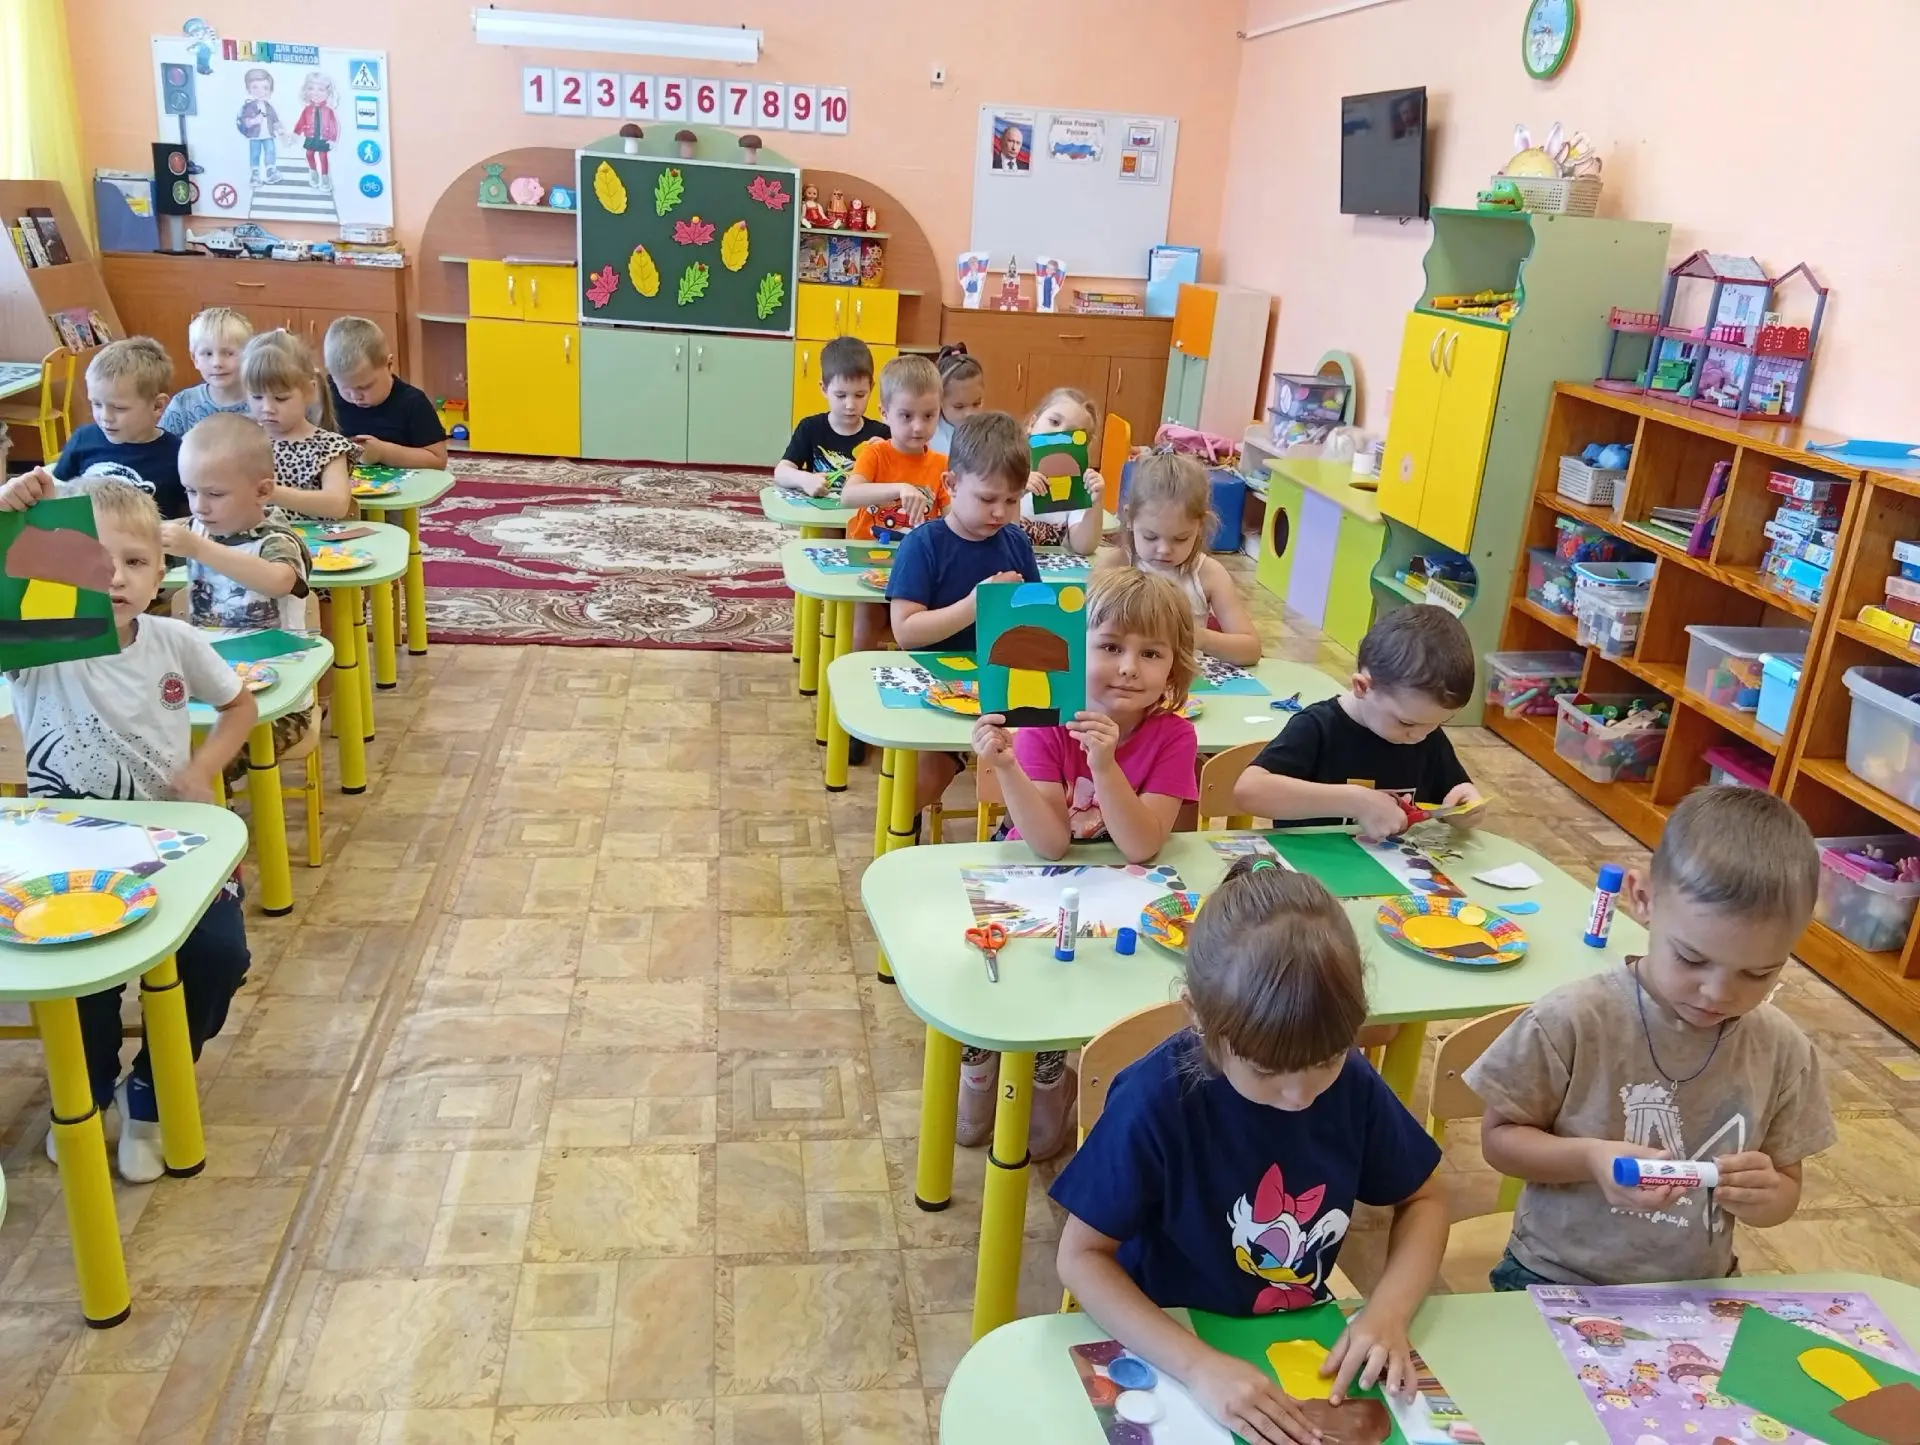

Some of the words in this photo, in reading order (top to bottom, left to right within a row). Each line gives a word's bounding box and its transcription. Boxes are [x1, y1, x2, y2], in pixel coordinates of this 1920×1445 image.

[222, 40, 270, 63] ПДД
[530, 75, 542, 102] 1
[563, 77, 581, 104] 2
[597, 78, 615, 107] 3
[629, 81, 649, 109] 4
[664, 83, 682, 111] 5
[697, 85, 715, 113] 6
[730, 88, 748, 115] 7
[763, 90, 779, 118] 8
[794, 93, 811, 120] 9
[821, 96, 847, 122] 10
[1005, 1084, 1015, 1099] 2
